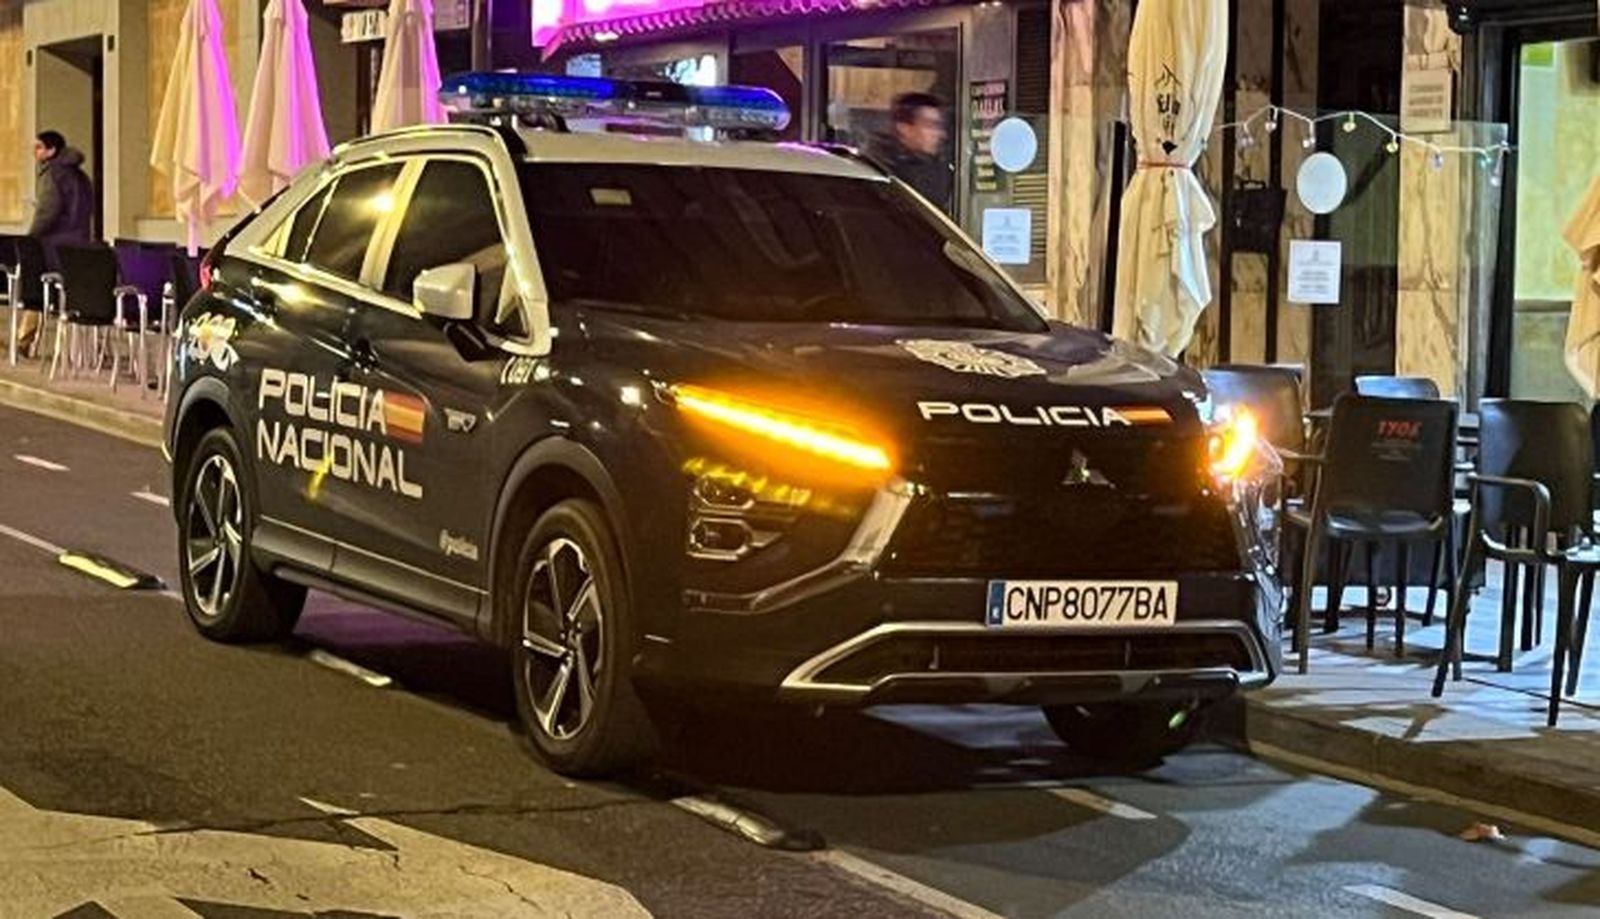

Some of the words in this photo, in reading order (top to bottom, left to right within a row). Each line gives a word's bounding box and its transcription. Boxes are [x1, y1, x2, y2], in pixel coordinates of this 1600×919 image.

[258, 368, 387, 435] POLICIA
[916, 401, 1131, 426] POLICIA
[257, 418, 423, 498] NACIONAL
[1006, 586, 1168, 620] CNP8077BA
